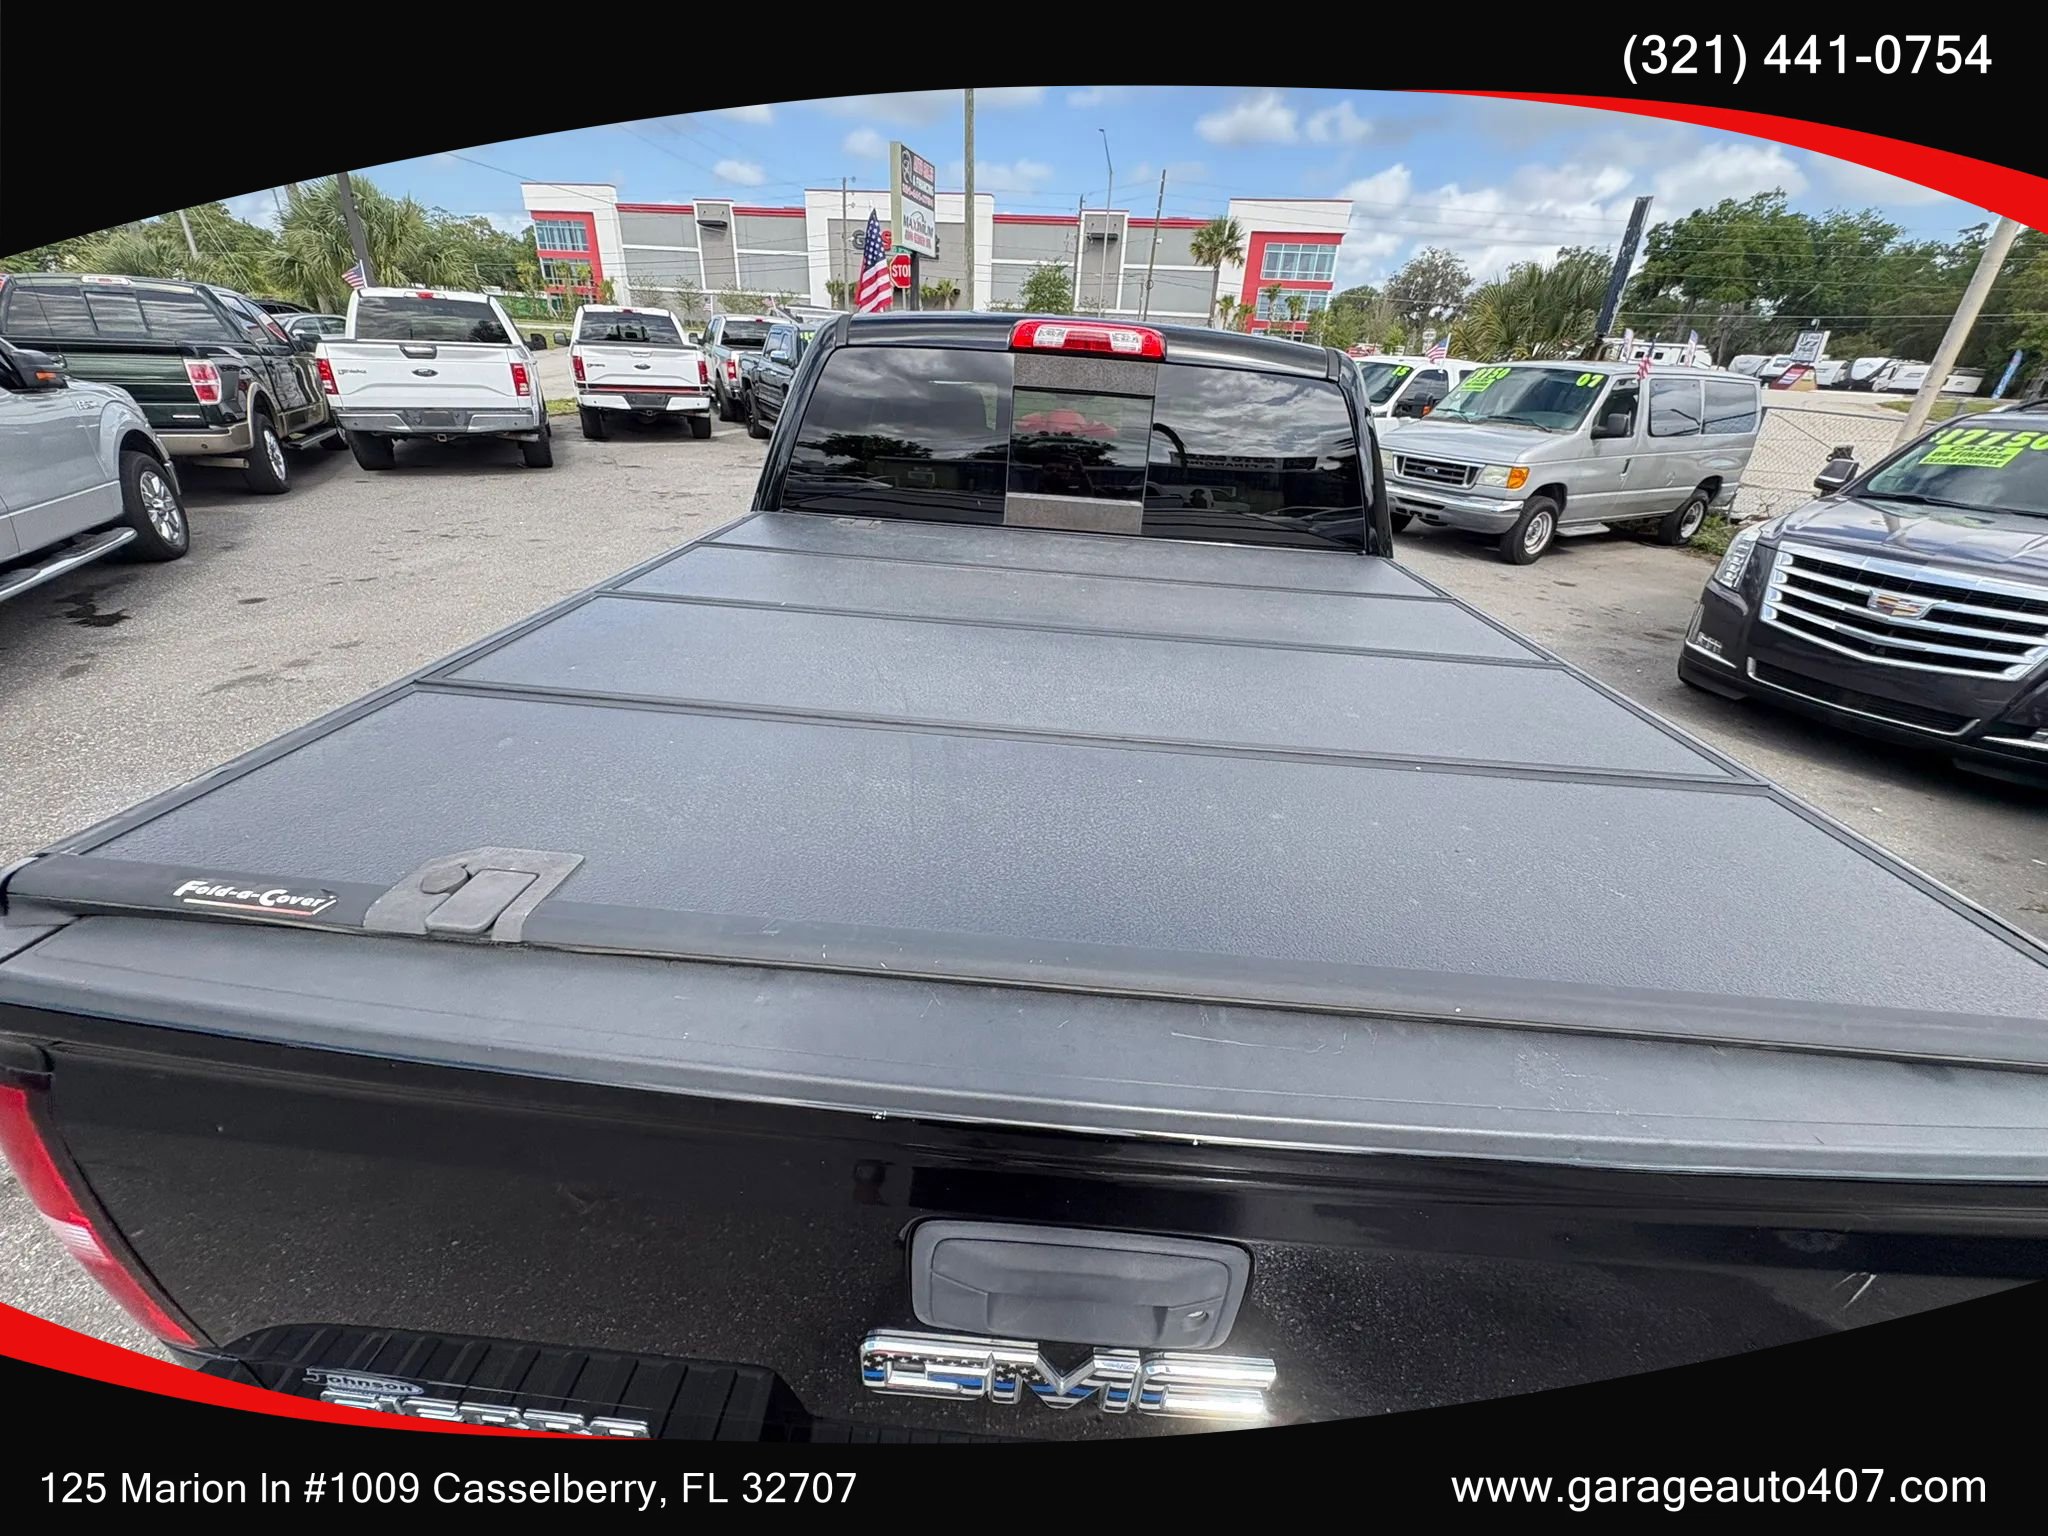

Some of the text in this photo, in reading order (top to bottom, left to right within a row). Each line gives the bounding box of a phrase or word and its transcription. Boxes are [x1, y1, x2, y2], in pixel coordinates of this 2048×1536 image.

[892, 265, 911, 277] STO
[1391, 366, 1411, 377] 15
[1575, 373, 1604, 388] 07
[173, 880, 327, 907] Fold-a-Cover
[860, 1329, 1278, 1421] GMC
